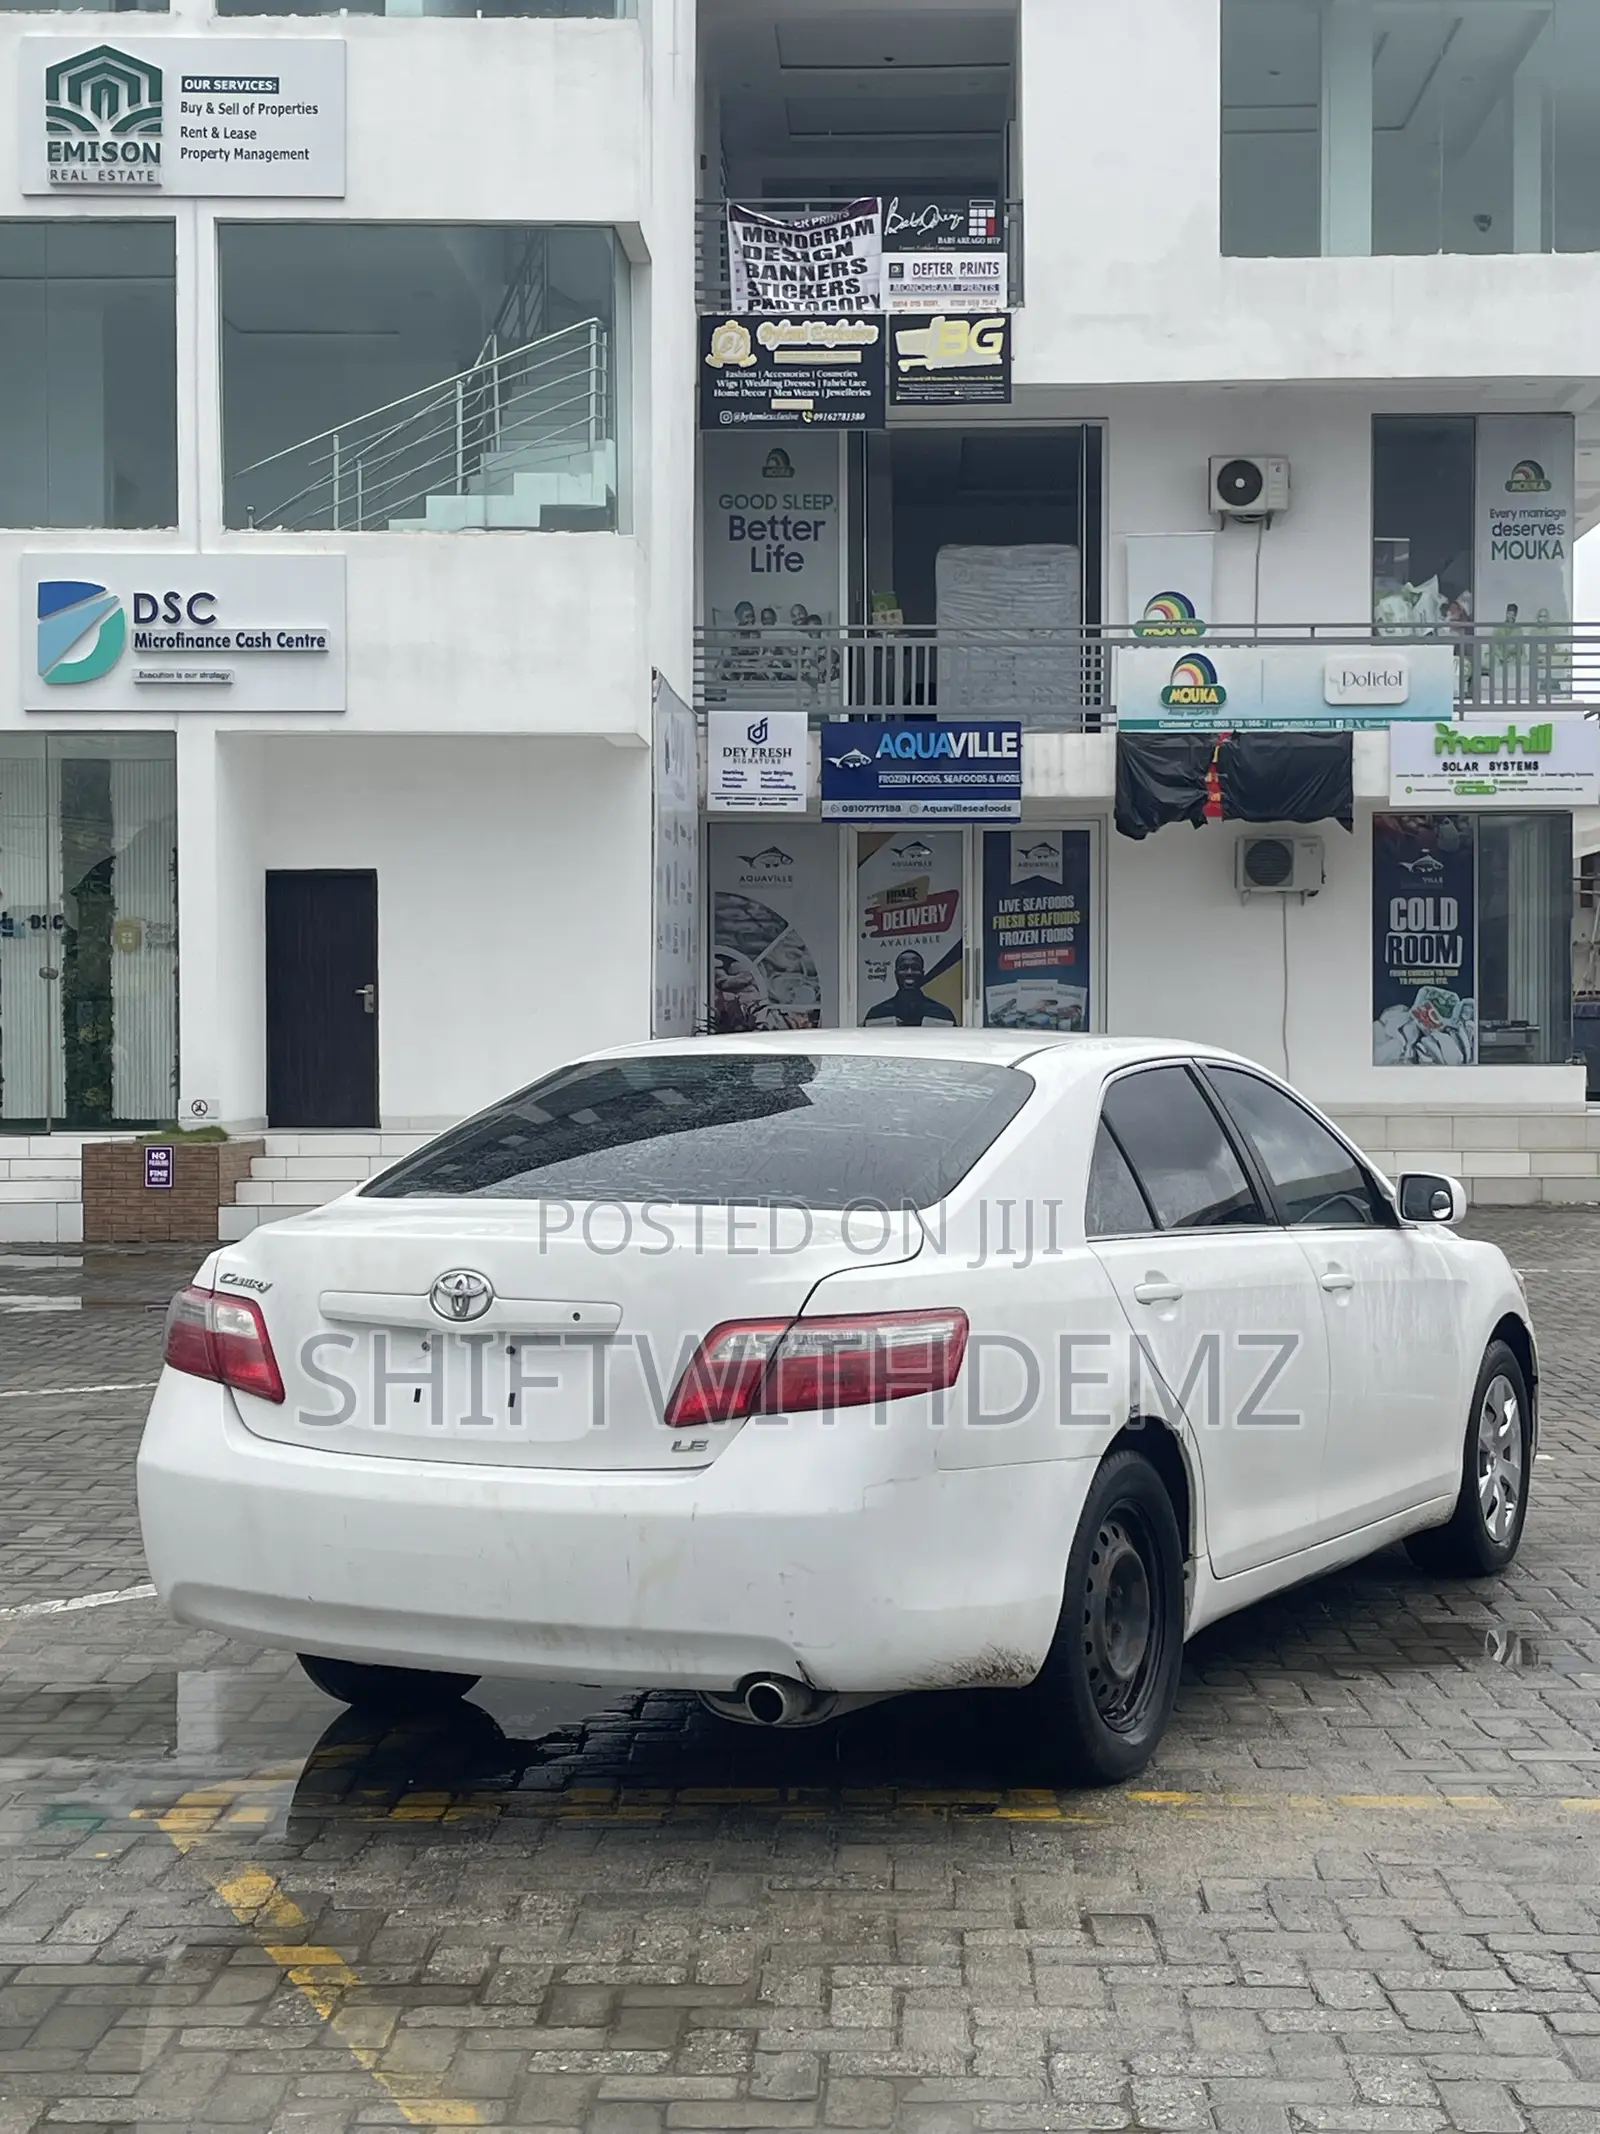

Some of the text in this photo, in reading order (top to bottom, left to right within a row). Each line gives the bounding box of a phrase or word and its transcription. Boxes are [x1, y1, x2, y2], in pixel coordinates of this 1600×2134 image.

[184, 78, 277, 91] OUR SERVICES:
[180, 101, 318, 118] Buy & Sell of Properties
[180, 126, 257, 140] Rent & Lease
[47, 140, 161, 164] EMISON
[180, 147, 310, 163] Property Management
[50, 169, 155, 183] REAL ESTATE
[742, 218, 875, 250] MONOGRAM
[742, 241, 854, 263] DESIGN
[745, 257, 868, 282] BANNERS
[912, 261, 1000, 276] DEFTER PRINTS
[747, 278, 861, 300] STICKERS
[725, 370, 858, 378] Fashion Accessories Cosmetics
[716, 379, 867, 389] Wigs Wedding Dresses Fabric Lace
[714, 388, 872, 398] Home Decor Men Wears Jewelleries
[718, 494, 777, 511] GOOD
[1489, 507, 1567, 521] Every marriage
[728, 514, 827, 542] Better
[1491, 522, 1566, 537] deserves
[750, 543, 805, 573] Life
[1491, 539, 1565, 561] MOUKA
[133, 590, 218, 626] DSC
[134, 631, 327, 649] Microfinance Cash Centre
[176, 670, 183, 679] is
[1342, 670, 1404, 687] Dolidol
[1168, 687, 1220, 704] MOUKA
[722, 747, 793, 759] DEY FRESH
[875, 731, 1018, 760] AQUAVILLE
[1442, 760, 1539, 772] SOLAR SYSTEMS
[878, 774, 911, 784] FROZEN
[943, 774, 988, 784] SEAFOODS
[988, 774, 995, 784] &
[739, 875, 794, 883] AQUAVILLE
[998, 895, 1076, 914] LIVE SEAFOODS
[882, 903, 949, 932] DELIVERY
[992, 910, 1081, 930] FRESH SEAFOODS
[1389, 896, 1459, 932] COLD
[879, 935, 941, 948] AVAILABLE
[999, 926, 1075, 947] FROZEN FOODS
[1387, 934, 1460, 965] ROOM
[151, 1151, 167, 1160] NO
[671, 1438, 710, 1453] LE
